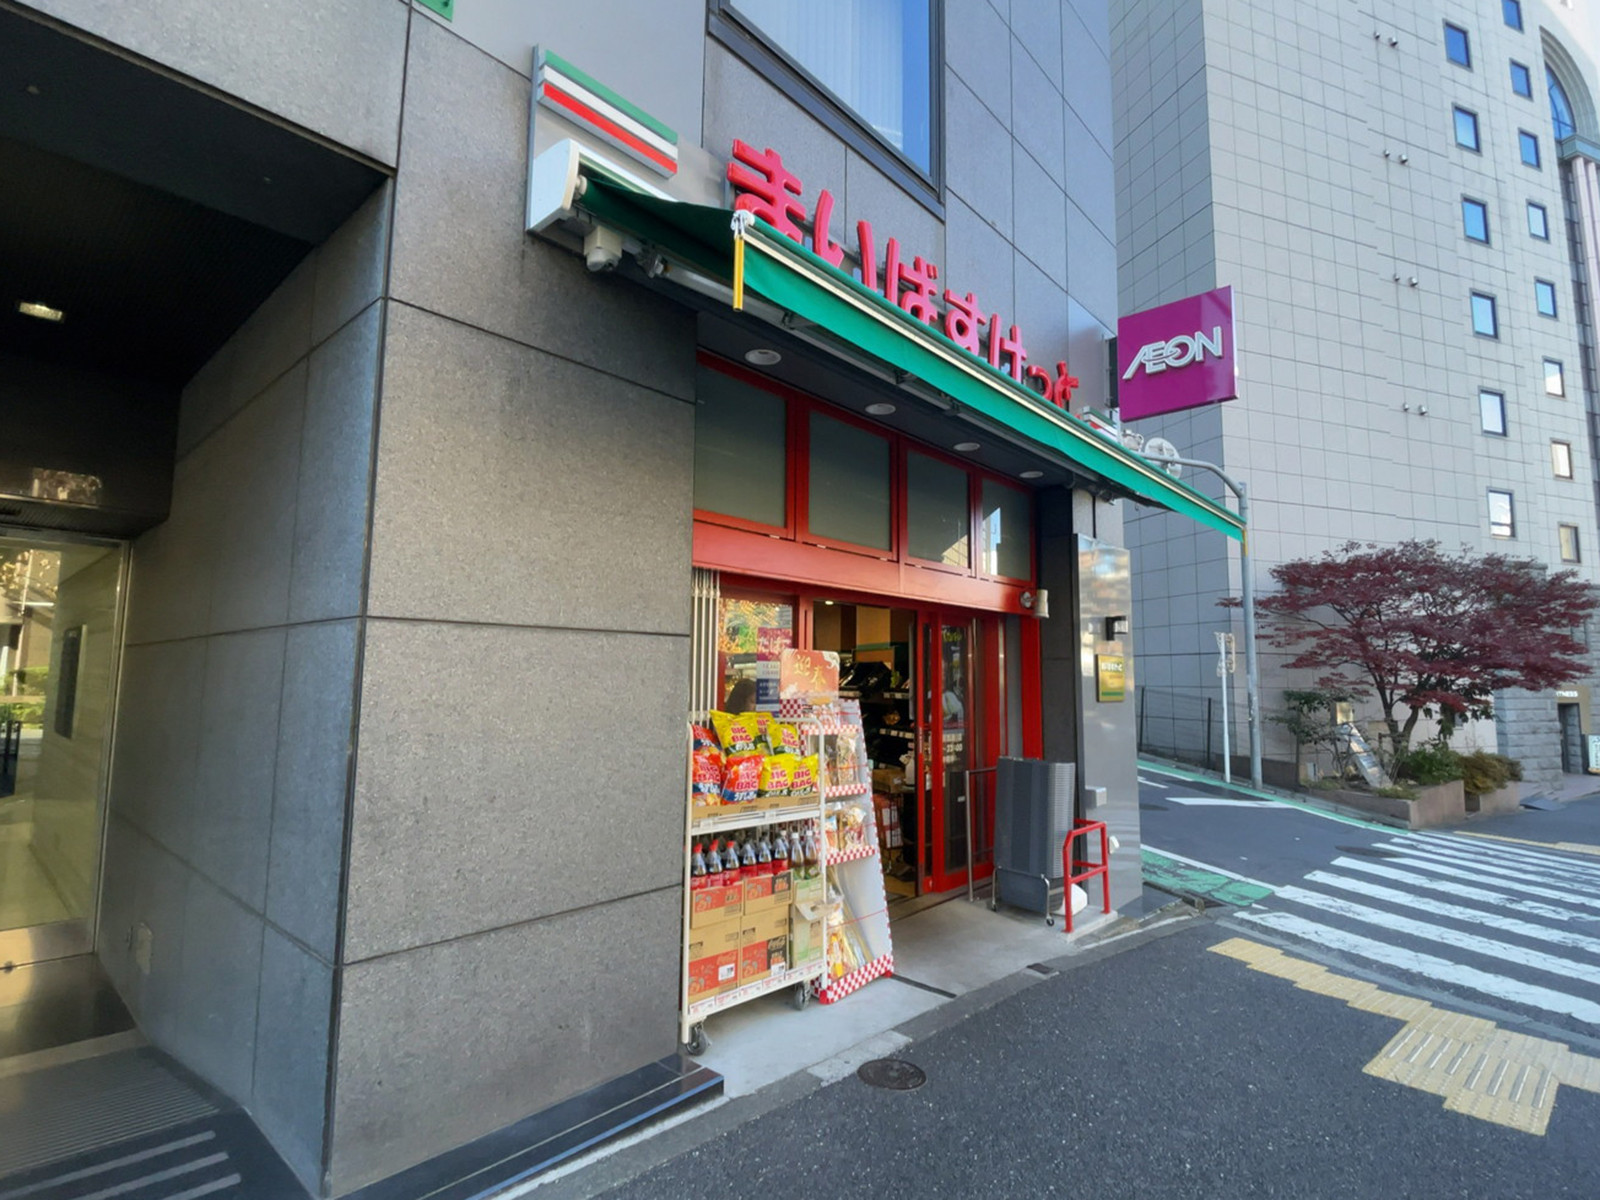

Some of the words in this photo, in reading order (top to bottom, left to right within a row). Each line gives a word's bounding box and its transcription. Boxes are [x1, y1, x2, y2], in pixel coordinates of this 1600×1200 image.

[726, 138, 1079, 408] まいばすけっと
[1122, 326, 1223, 380] AEON
[731, 727, 747, 735] BIG
[731, 735, 752, 743] BAG
[793, 769, 811, 779] BIG
[736, 781, 757, 790] BAG
[766, 779, 788, 789] BAG
[791, 778, 812, 789] BAG
